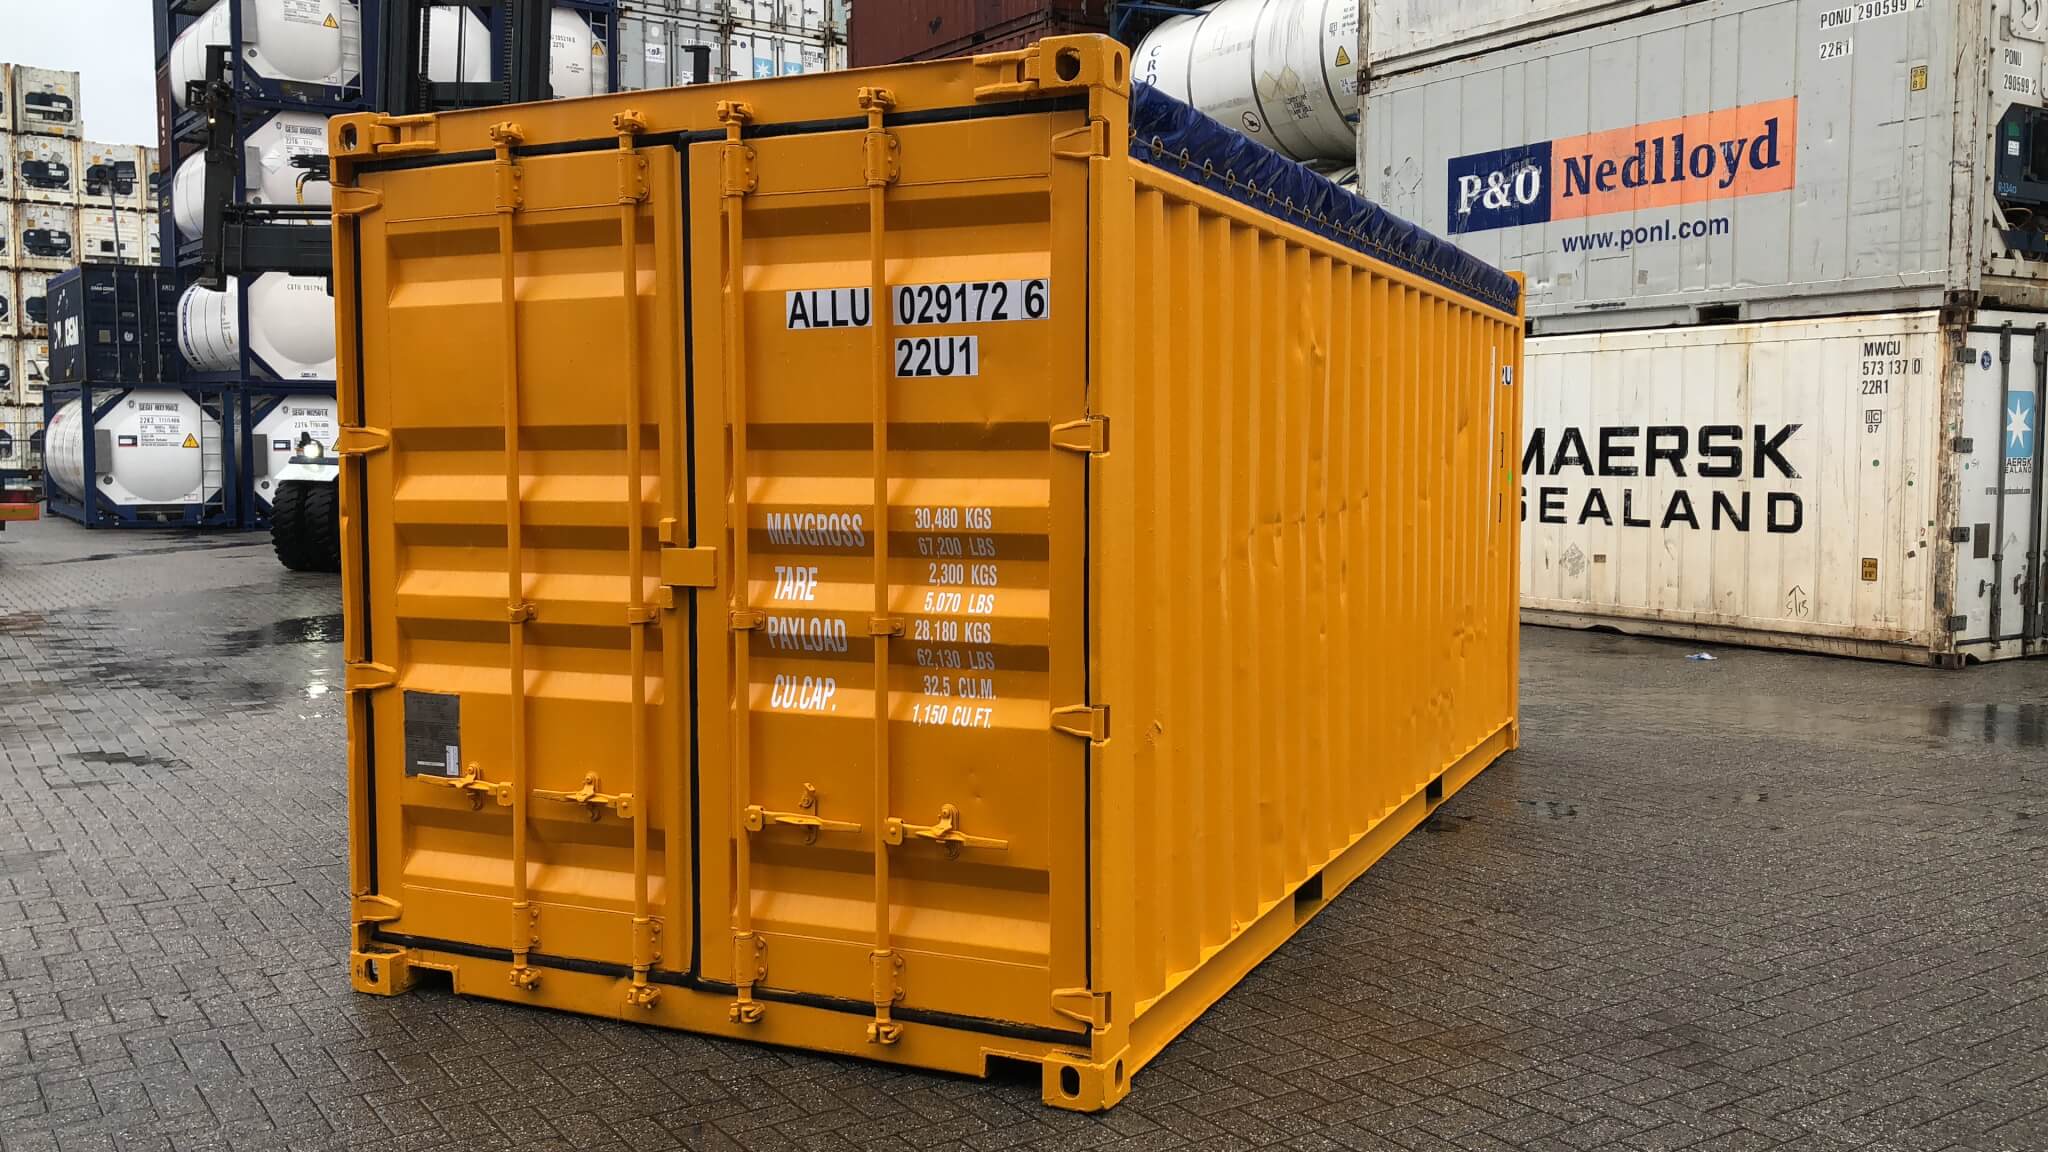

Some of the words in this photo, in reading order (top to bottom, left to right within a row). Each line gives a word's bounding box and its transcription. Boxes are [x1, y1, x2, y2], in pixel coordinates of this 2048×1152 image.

[1820, 8, 1852, 28] PONU
[1858, 0, 1907, 20] 290599
[1820, 41, 1849, 59] 22R1
[2005, 49, 2021, 66] PONU
[2004, 74, 2030, 93] 290599
[2032, 80, 2037, 95] 2
[1456, 164, 1542, 214] P&O
[1563, 117, 1780, 197] Nedlloyd
[1562, 216, 1729, 252] www.ponl.com
[788, 288, 870, 329] ALLU
[900, 282, 1009, 325] 029172
[1025, 280, 1045, 319] 6
[897, 337, 972, 377] 22U1
[1864, 341, 1900, 357] MWCU
[1863, 361, 1883, 375] 573
[1889, 360, 1908, 375] 137
[1914, 359, 1921, 374] 0
[1862, 379, 1889, 394] 22R1
[2004, 466, 2032, 474] EALAND
[2006, 457, 2032, 467] AERSK
[915, 507, 958, 529] 30,480
[965, 508, 992, 529] KGS
[1521, 486, 1803, 534] EALAND
[767, 513, 865, 547] MAXGROSS
[919, 537, 962, 558] 67,200
[969, 538, 996, 557] LBS
[774, 566, 818, 601] TARE
[929, 563, 963, 586] 2,300
[971, 564, 997, 586] KGS
[924, 592, 961, 613] 5,070
[968, 593, 995, 614] LBS
[767, 616, 848, 652] PAYLOAD
[915, 620, 957, 642] 28,180
[965, 622, 991, 644] KGS
[917, 648, 961, 670] 62,130
[969, 650, 995, 670] LBS
[771, 674, 836, 711] CU.CAP.
[924, 675, 950, 697] 32.5
[959, 677, 997, 700] CU.M.
[912, 704, 948, 726] 1,150
[952, 706, 992, 728] CU.FT.
